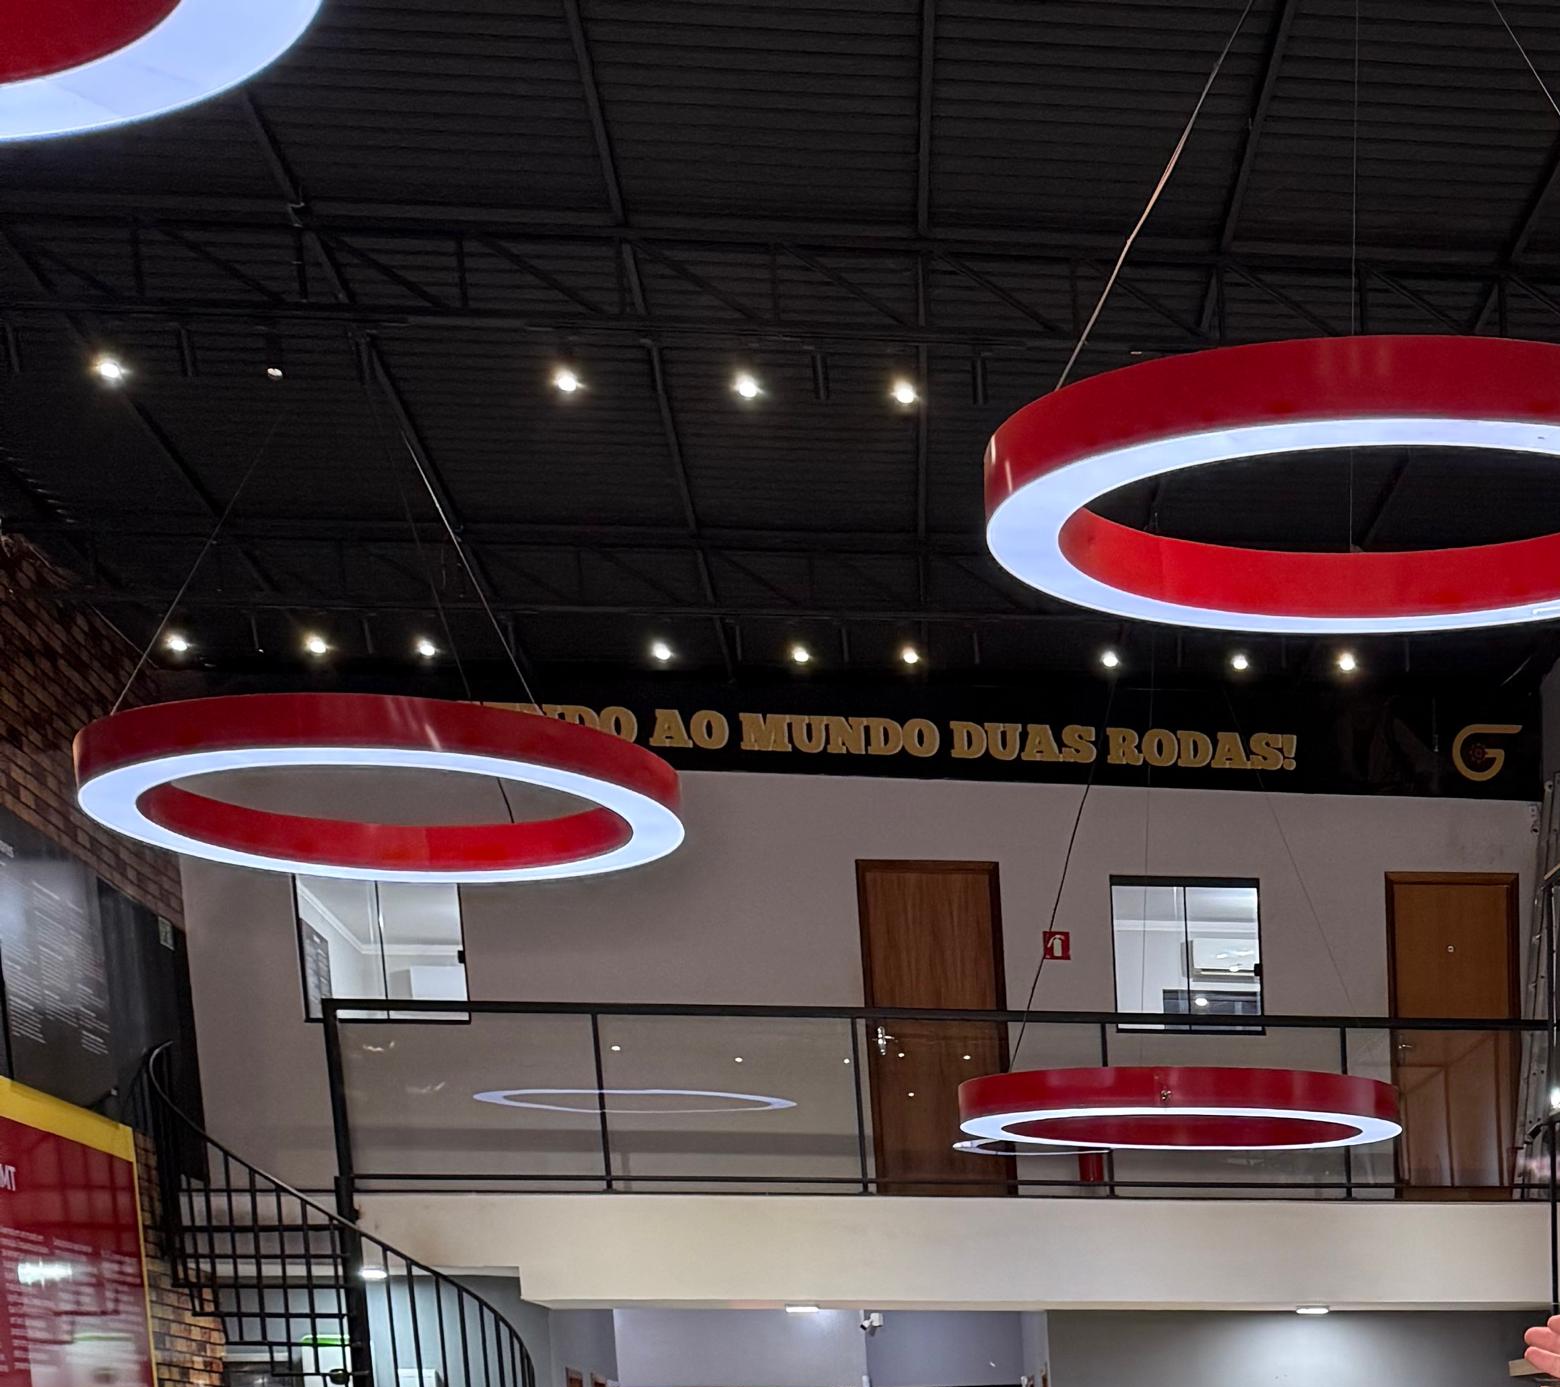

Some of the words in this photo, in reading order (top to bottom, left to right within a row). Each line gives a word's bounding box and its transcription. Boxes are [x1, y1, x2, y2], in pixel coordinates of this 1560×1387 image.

[650, 709, 729, 749] AO
[739, 713, 940, 758] MUNDO
[949, 720, 1096, 763] DUAS
[1106, 727, 1297, 771] RODAS!
